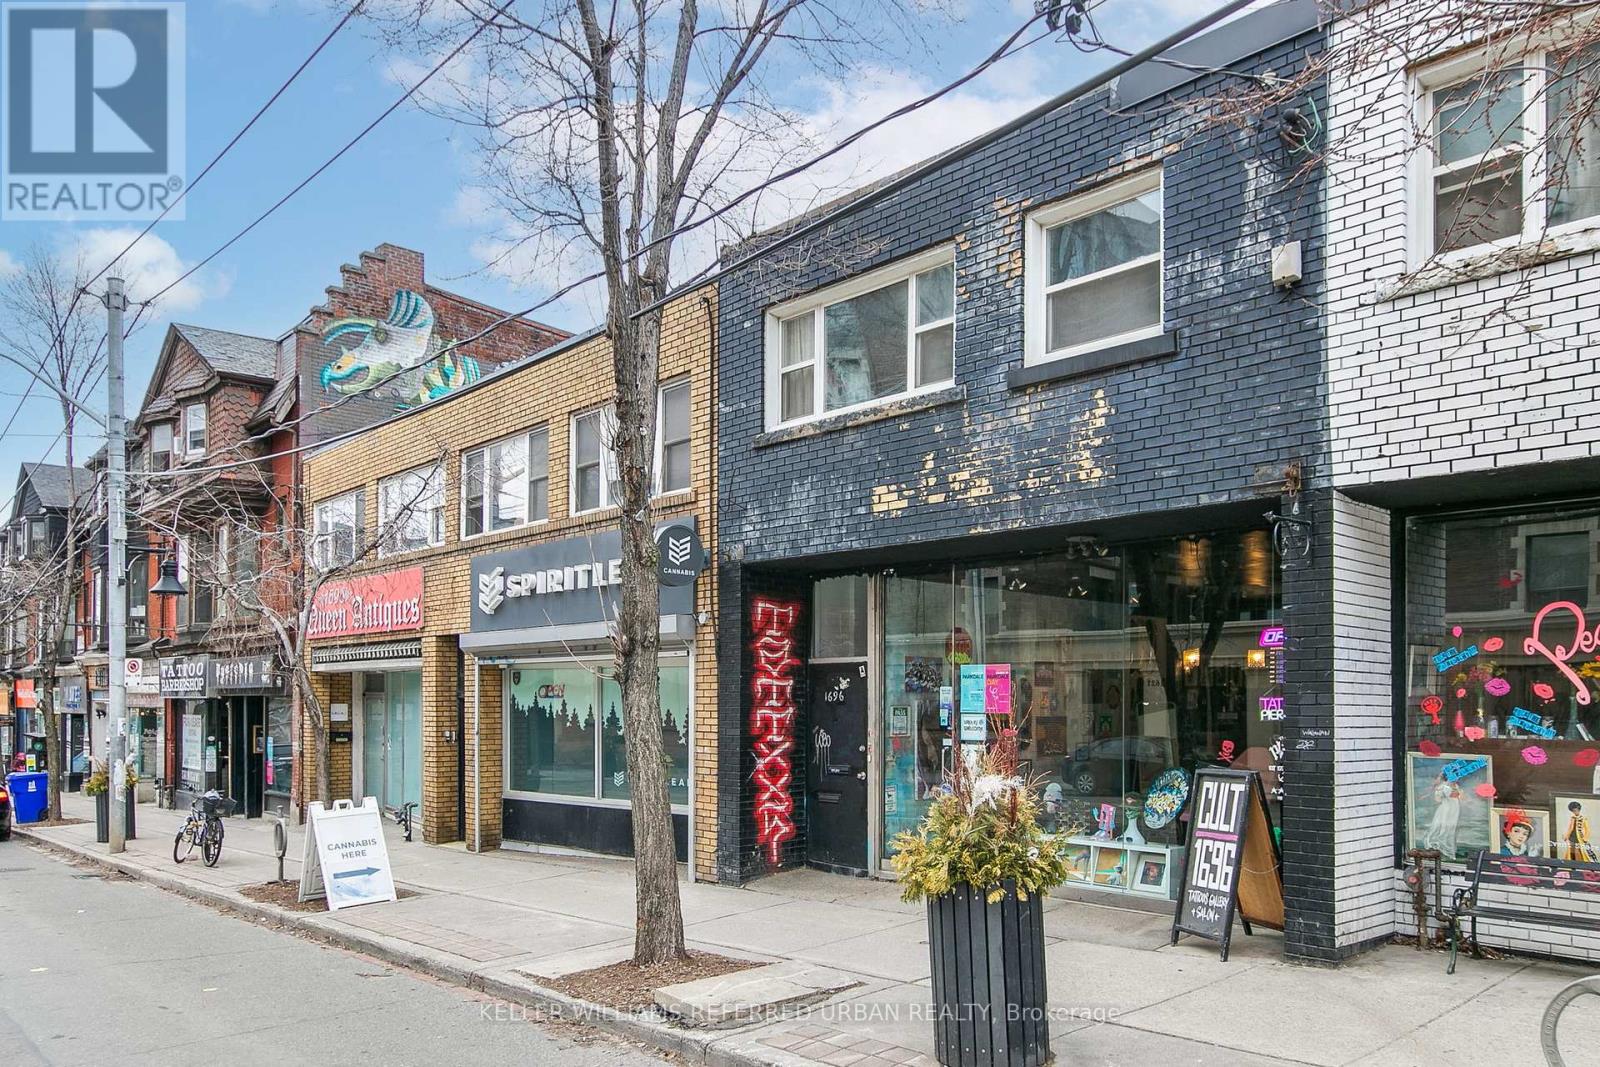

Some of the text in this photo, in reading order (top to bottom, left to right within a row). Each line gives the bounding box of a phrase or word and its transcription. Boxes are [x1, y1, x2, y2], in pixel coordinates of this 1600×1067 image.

[506, 558, 622, 598] SPIRITLE
[663, 567, 695, 576] CANNABIS
[352, 594, 421, 632] Antiques
[161, 662, 204, 677] TATTOO
[161, 677, 205, 692] BARBERSHOP
[824, 691, 844, 702] 1696
[1259, 697, 1284, 710] TAT
[1260, 709, 1284, 721] PIER
[1198, 781, 1245, 833] CULT
[327, 838, 377, 851] CANNABIS
[341, 849, 367, 860] HERE
[1192, 838, 1238, 893] 1696
